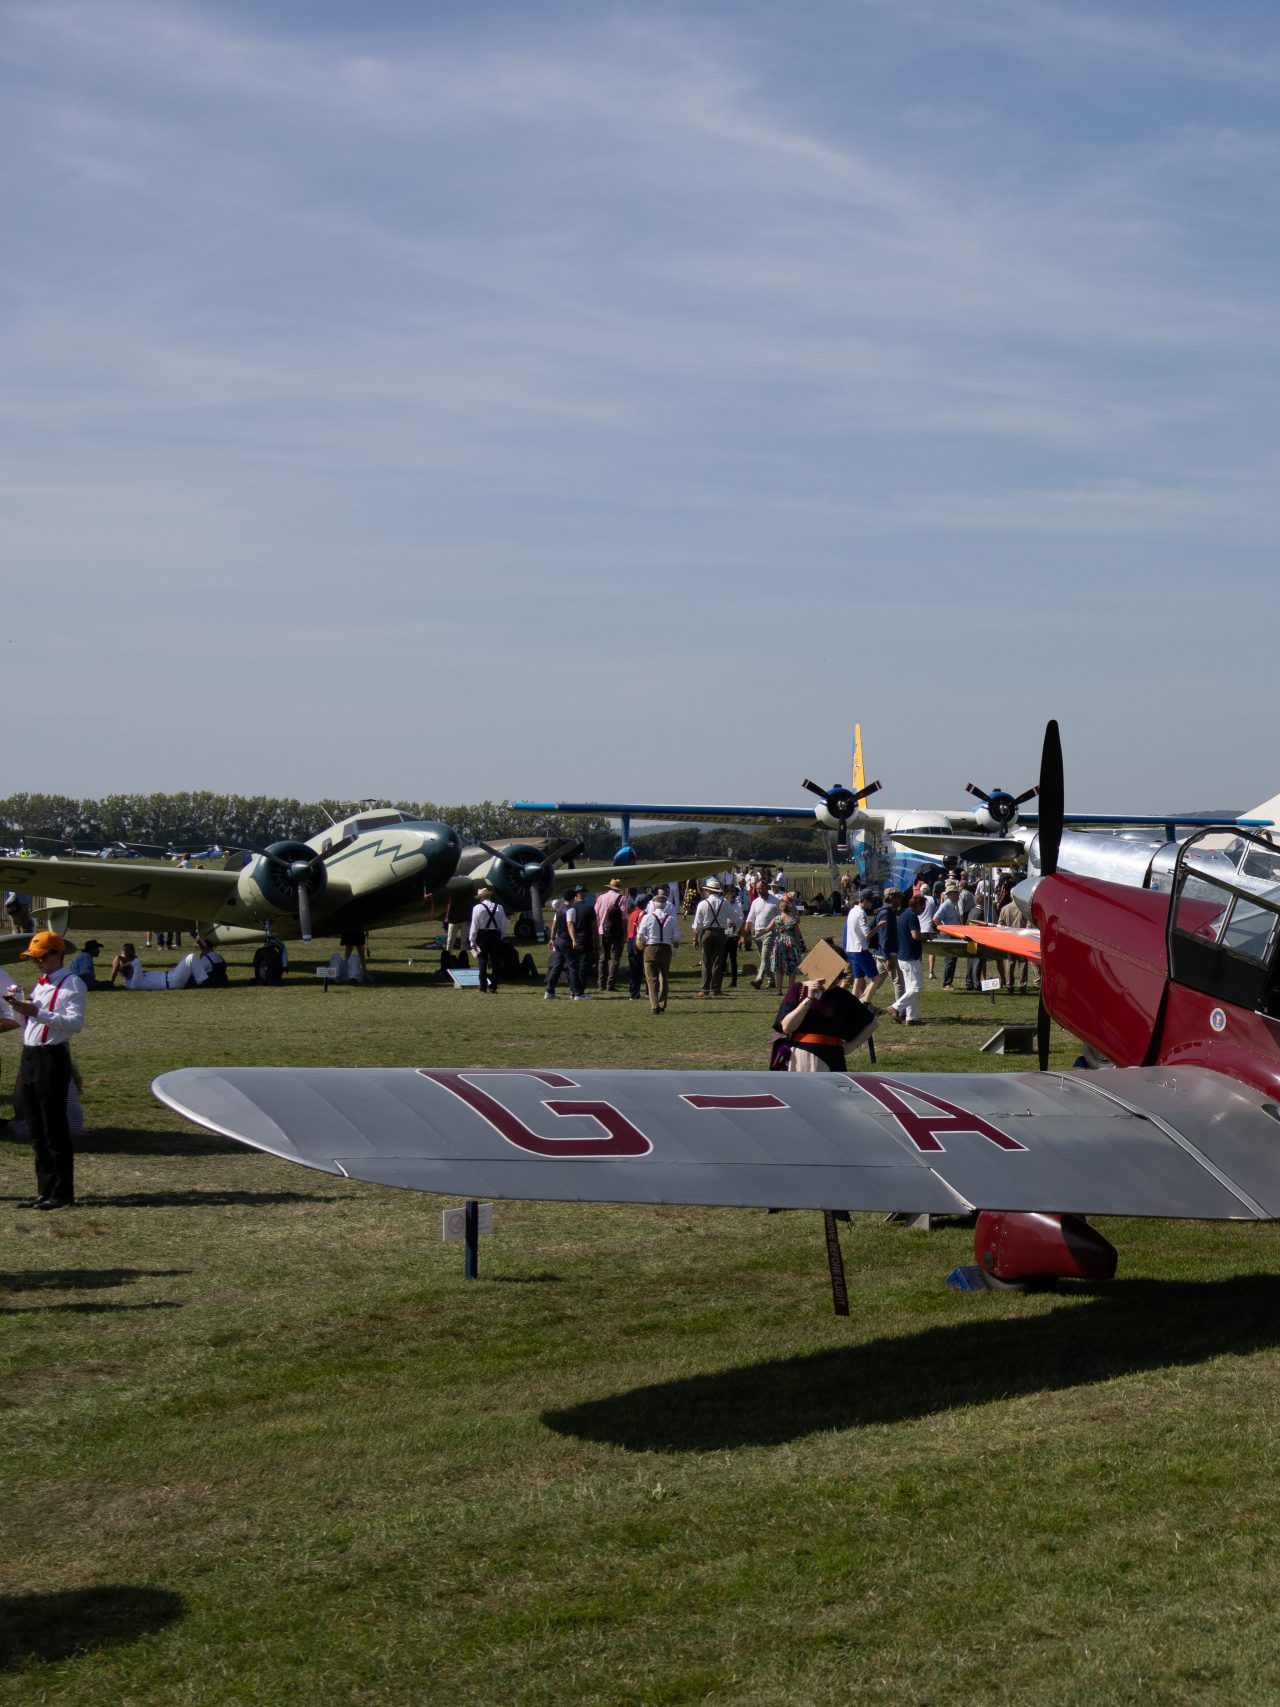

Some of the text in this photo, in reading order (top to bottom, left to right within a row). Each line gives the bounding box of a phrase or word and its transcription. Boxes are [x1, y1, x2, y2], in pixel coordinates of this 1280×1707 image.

[825, 1211, 846, 1307] EMOVE BEFORE FLIGHT
